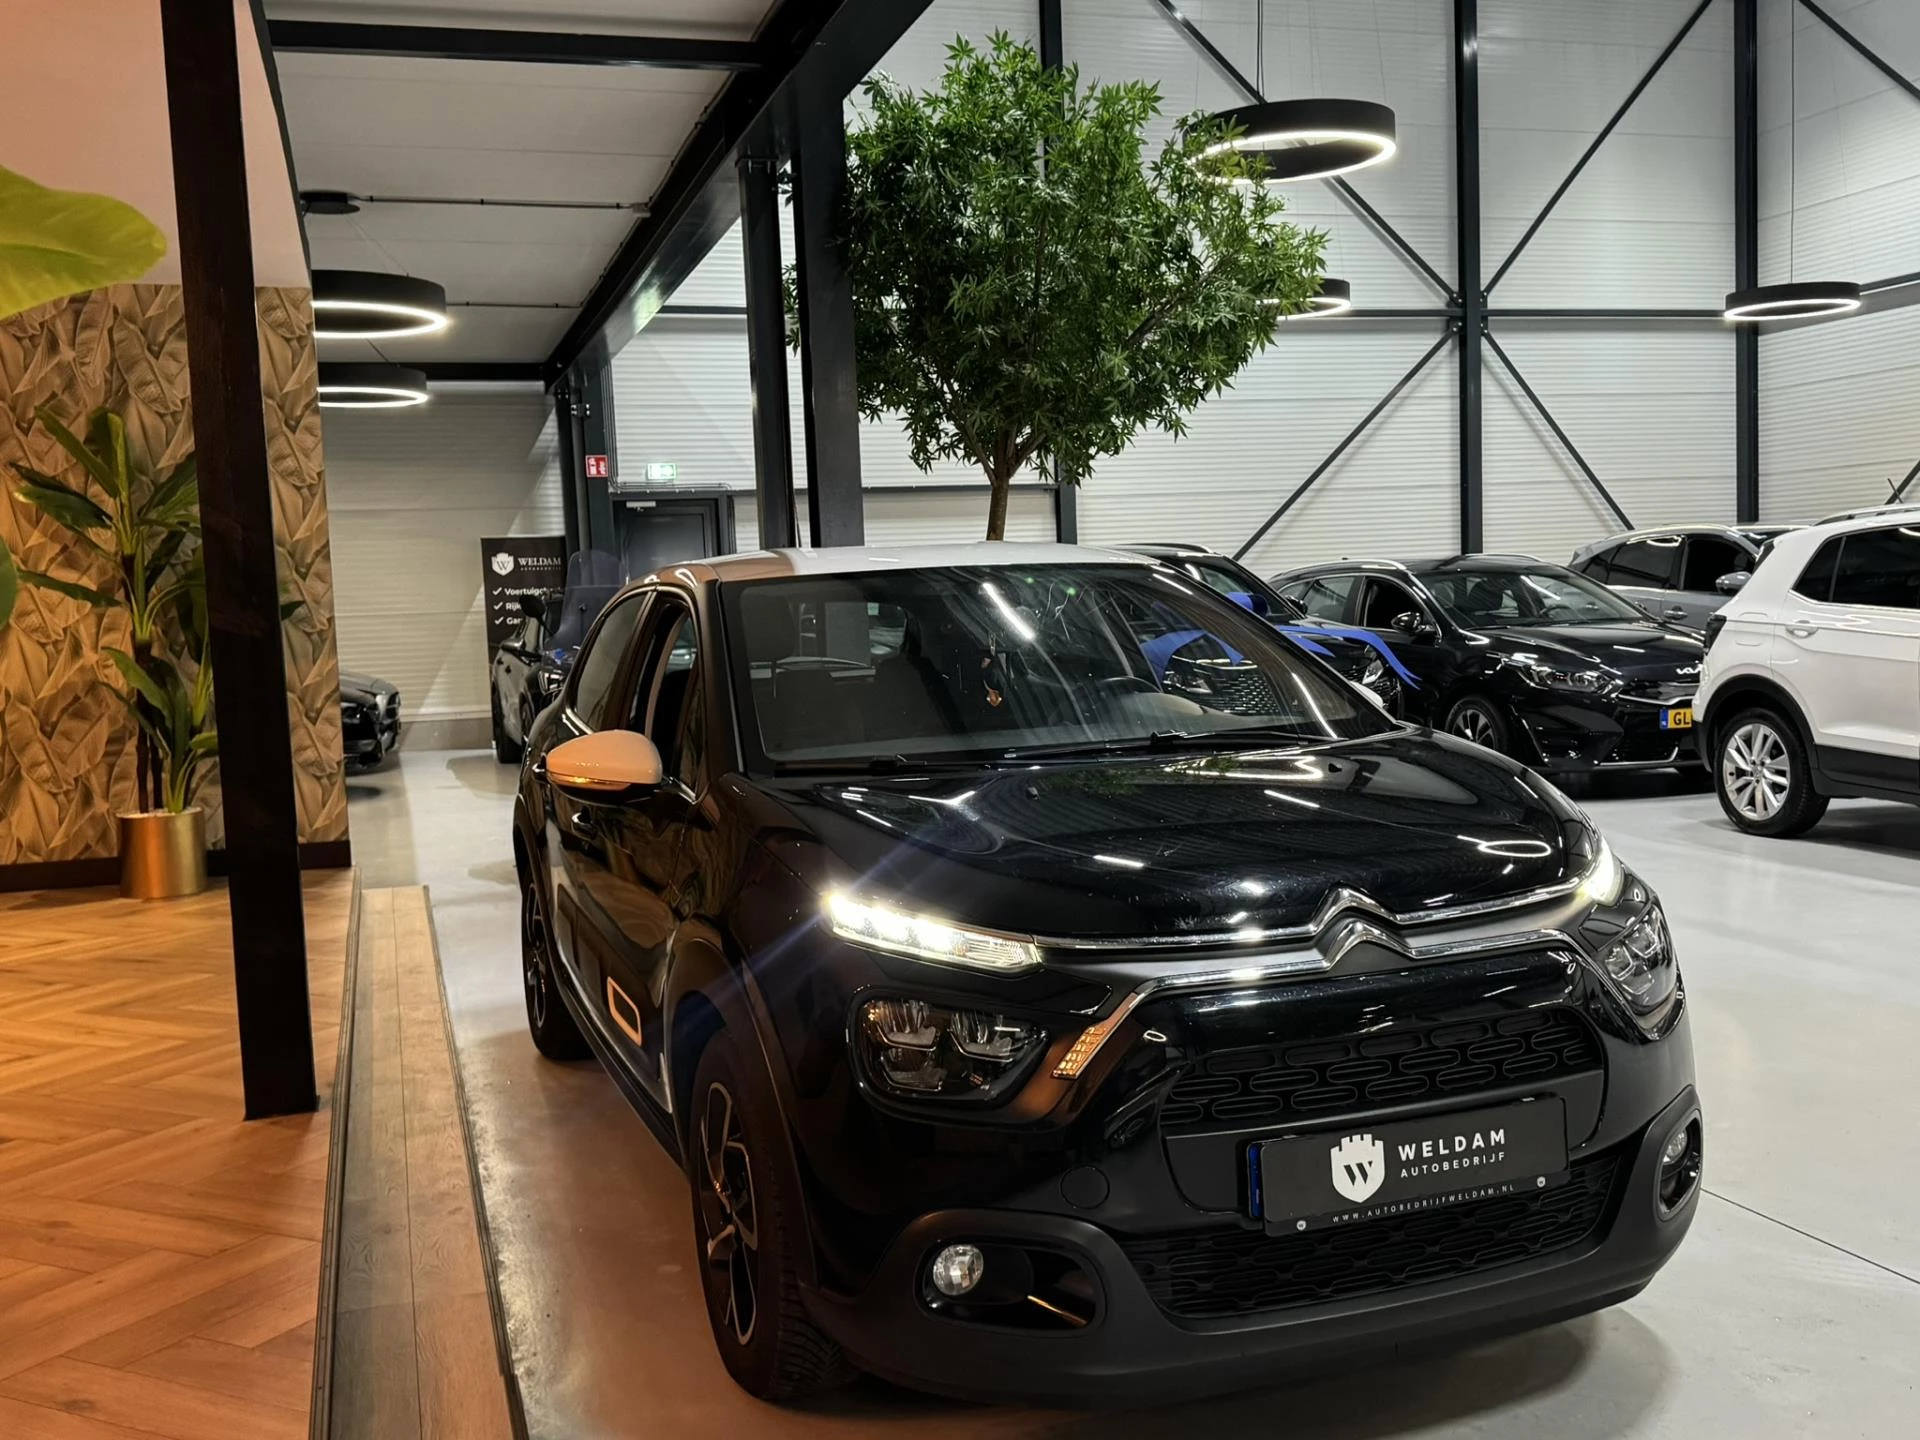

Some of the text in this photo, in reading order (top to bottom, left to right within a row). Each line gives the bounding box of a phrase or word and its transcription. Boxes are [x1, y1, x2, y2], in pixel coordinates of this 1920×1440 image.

[518, 557, 561, 566] WELDAM
[504, 587, 562, 596] Voertuigc
[505, 602, 522, 611] Rijk
[506, 617, 523, 625] Gar
[1673, 711, 1692, 726] GL
[1398, 1129, 1505, 1161] WELDAM
[1400, 1151, 1505, 1178] AUTOBEDRIJF
[1332, 1184, 1514, 1223] WWW.AUTOBEDRIJFWELDAM.NL
